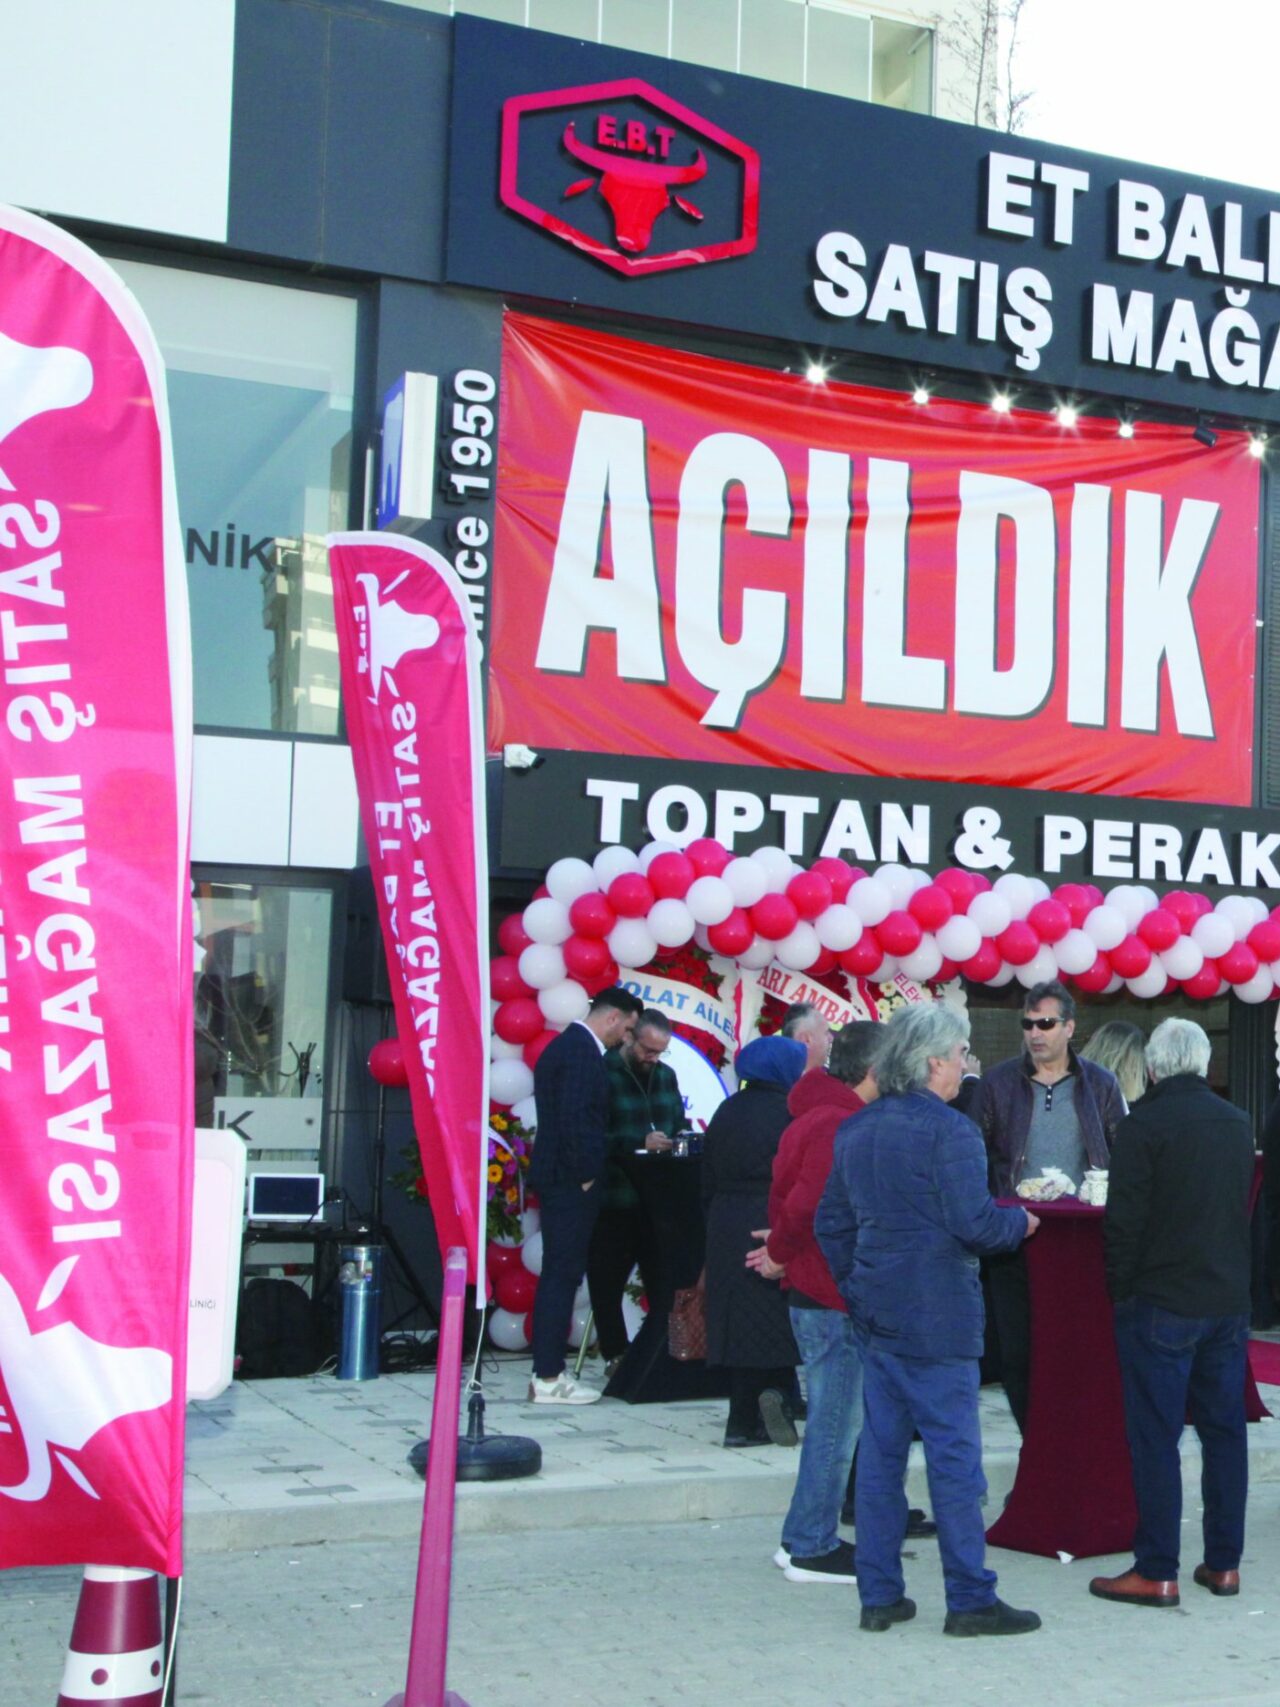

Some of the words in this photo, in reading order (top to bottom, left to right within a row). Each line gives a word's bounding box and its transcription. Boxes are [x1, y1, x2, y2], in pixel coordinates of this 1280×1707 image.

[597, 117, 675, 158] E.B.T
[987, 151, 1089, 244] ET
[814, 231, 1053, 371] SATIŞ
[450, 369, 496, 496] 1950
[455, 516, 490, 665] nce
[534, 409, 1220, 739] AÇILDIK
[586, 779, 931, 864] TOPTAN
[954, 806, 1015, 870] &
[615, 979, 690, 1011] OLAT
[790, 983, 857, 1025] AMBA
